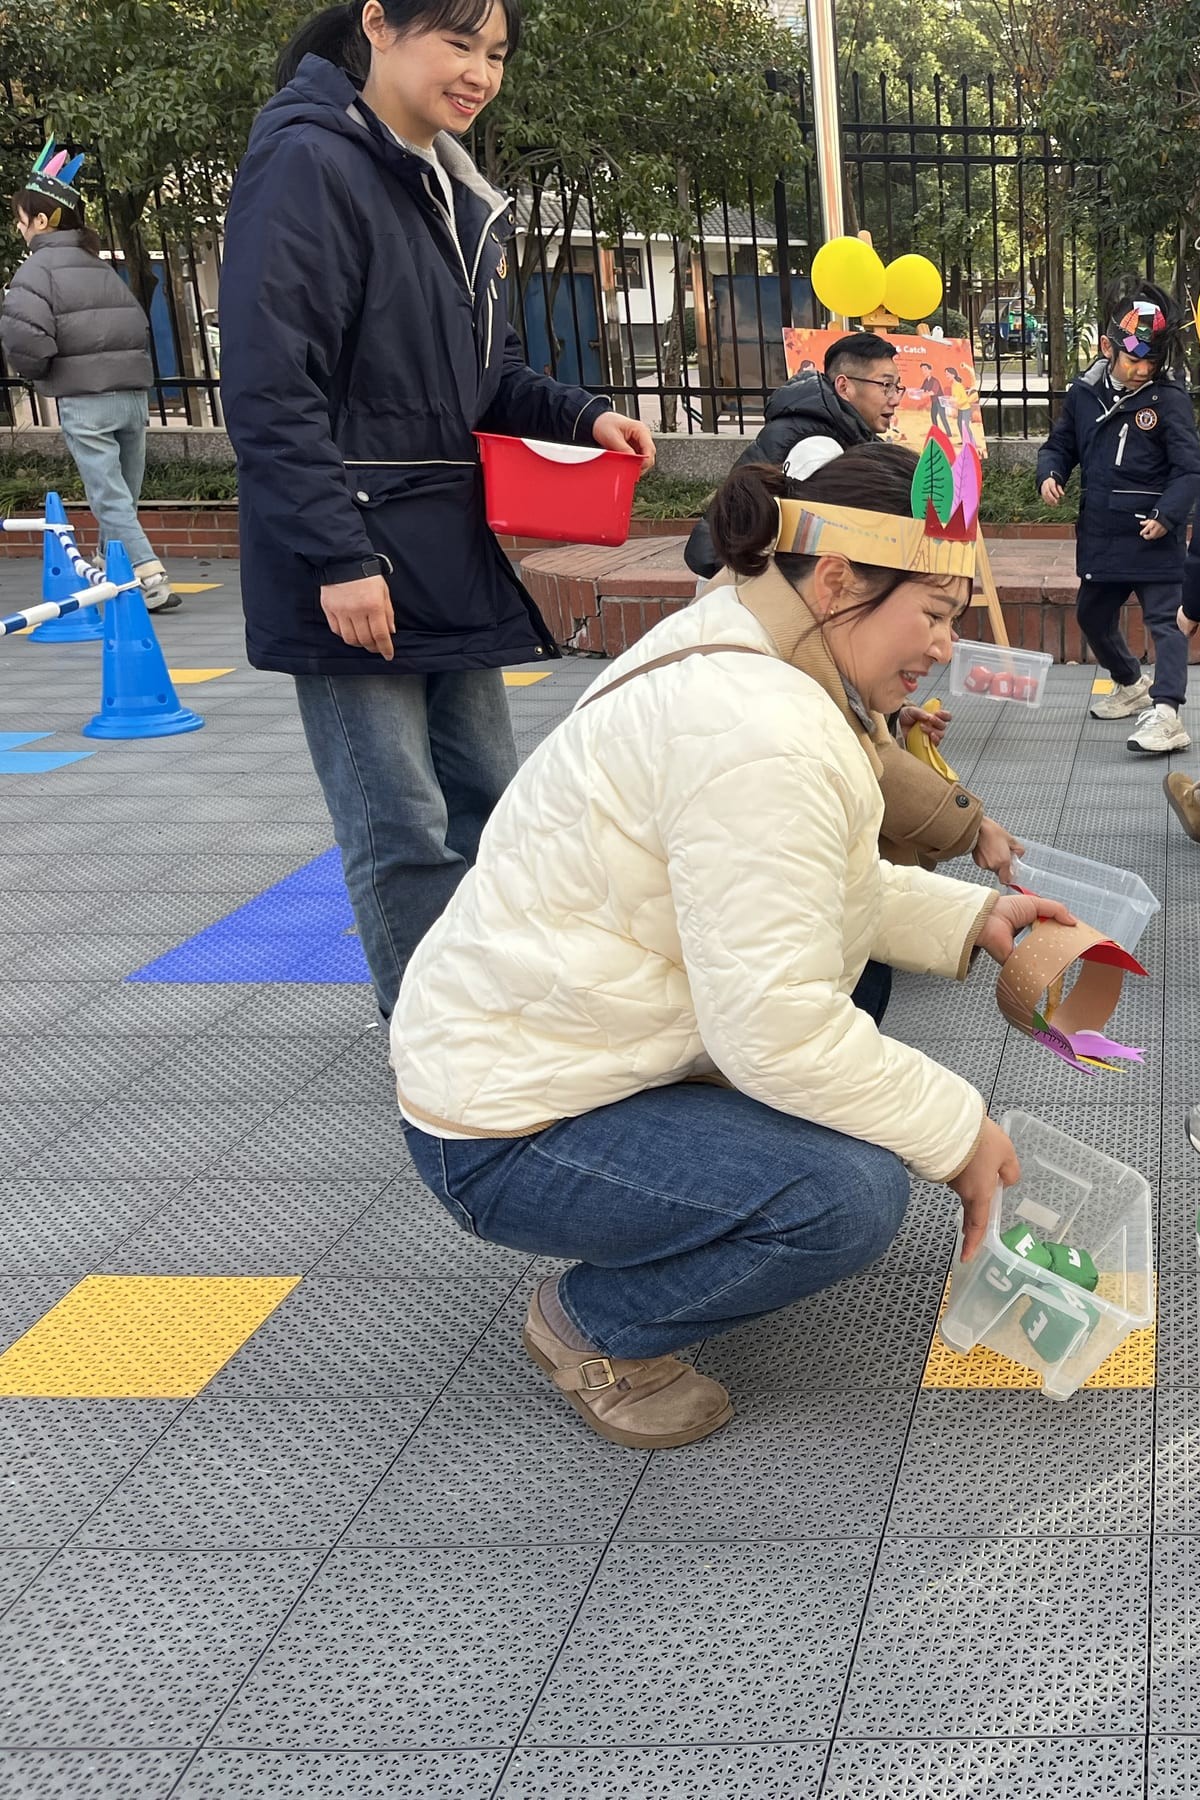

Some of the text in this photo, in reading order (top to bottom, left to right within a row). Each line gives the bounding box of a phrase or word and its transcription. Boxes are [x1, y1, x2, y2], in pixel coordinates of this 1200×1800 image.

[903, 345, 927, 354] Catch
[1000, 681, 1009, 693] B
[1014, 1232, 1036, 1258] E
[1067, 1247, 1081, 1268] E
[985, 1266, 1013, 1292] C
[1027, 1310, 1049, 1342] E
